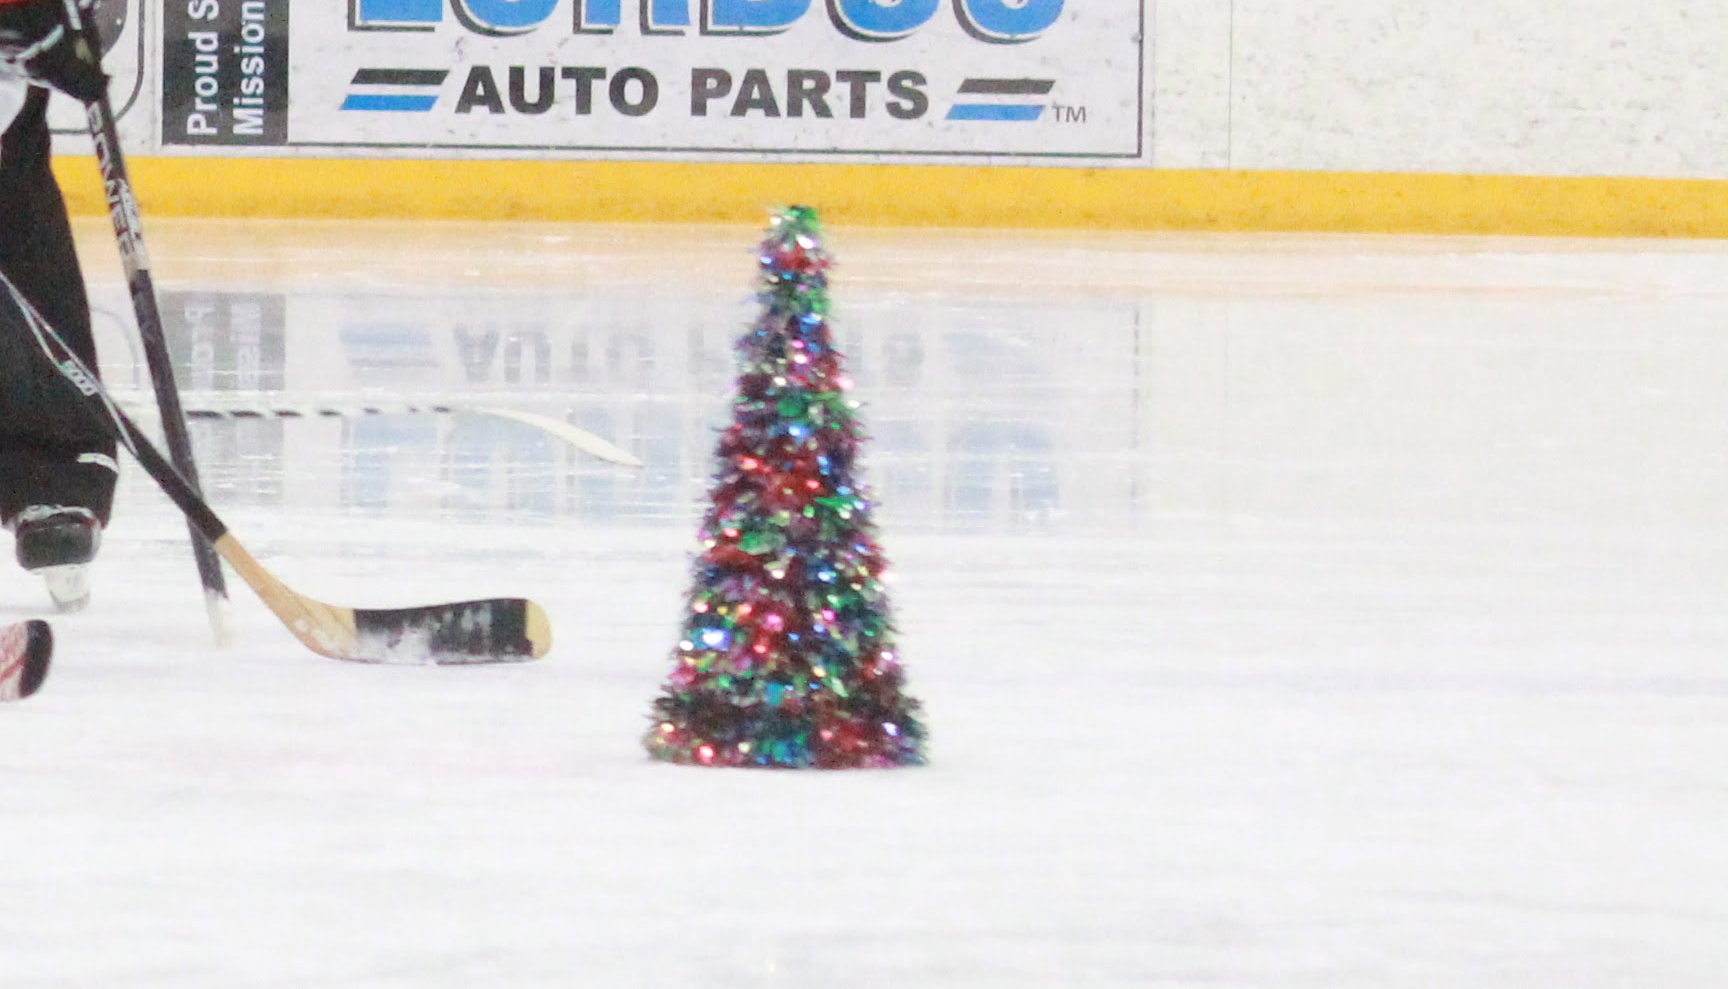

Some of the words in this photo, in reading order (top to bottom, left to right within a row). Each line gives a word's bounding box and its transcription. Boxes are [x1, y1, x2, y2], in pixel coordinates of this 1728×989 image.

[186, 31, 220, 137] Proud
[232, 0, 266, 136] Mission
[454, 65, 660, 117] AUTO
[690, 66, 931, 121] PARTS
